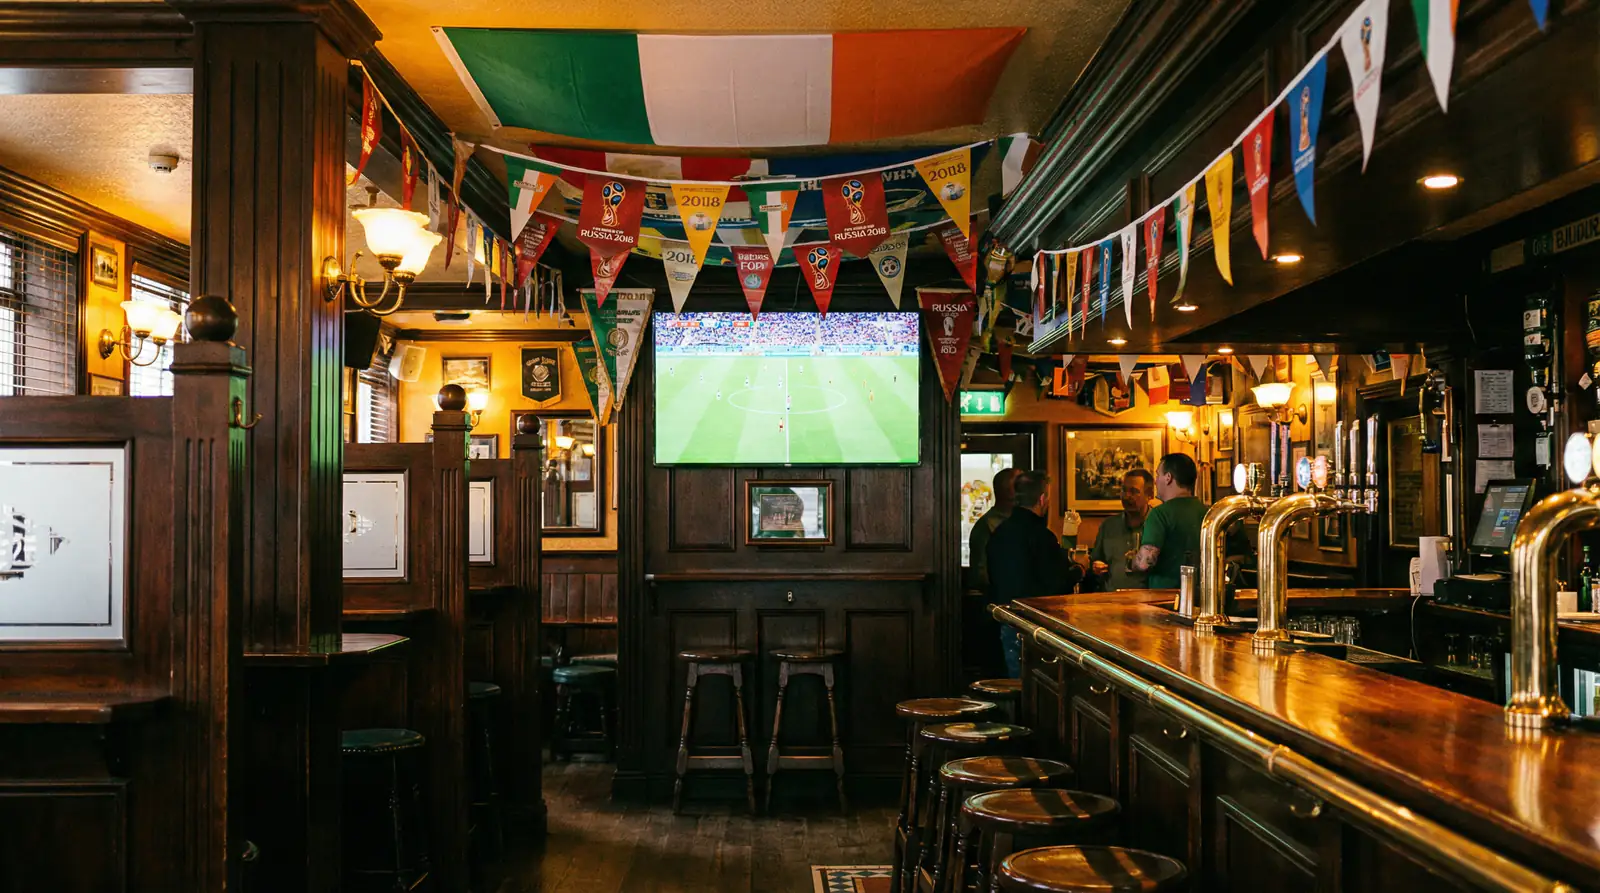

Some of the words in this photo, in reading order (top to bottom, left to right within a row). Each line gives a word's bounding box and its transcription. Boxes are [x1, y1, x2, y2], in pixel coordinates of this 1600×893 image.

[580, 229, 613, 241] RUSSIA
[613, 234, 634, 244] 2018
[835, 230, 867, 241] RUSSIA
[866, 227, 887, 237] 2018
[931, 303, 968, 312] RUSSIA
